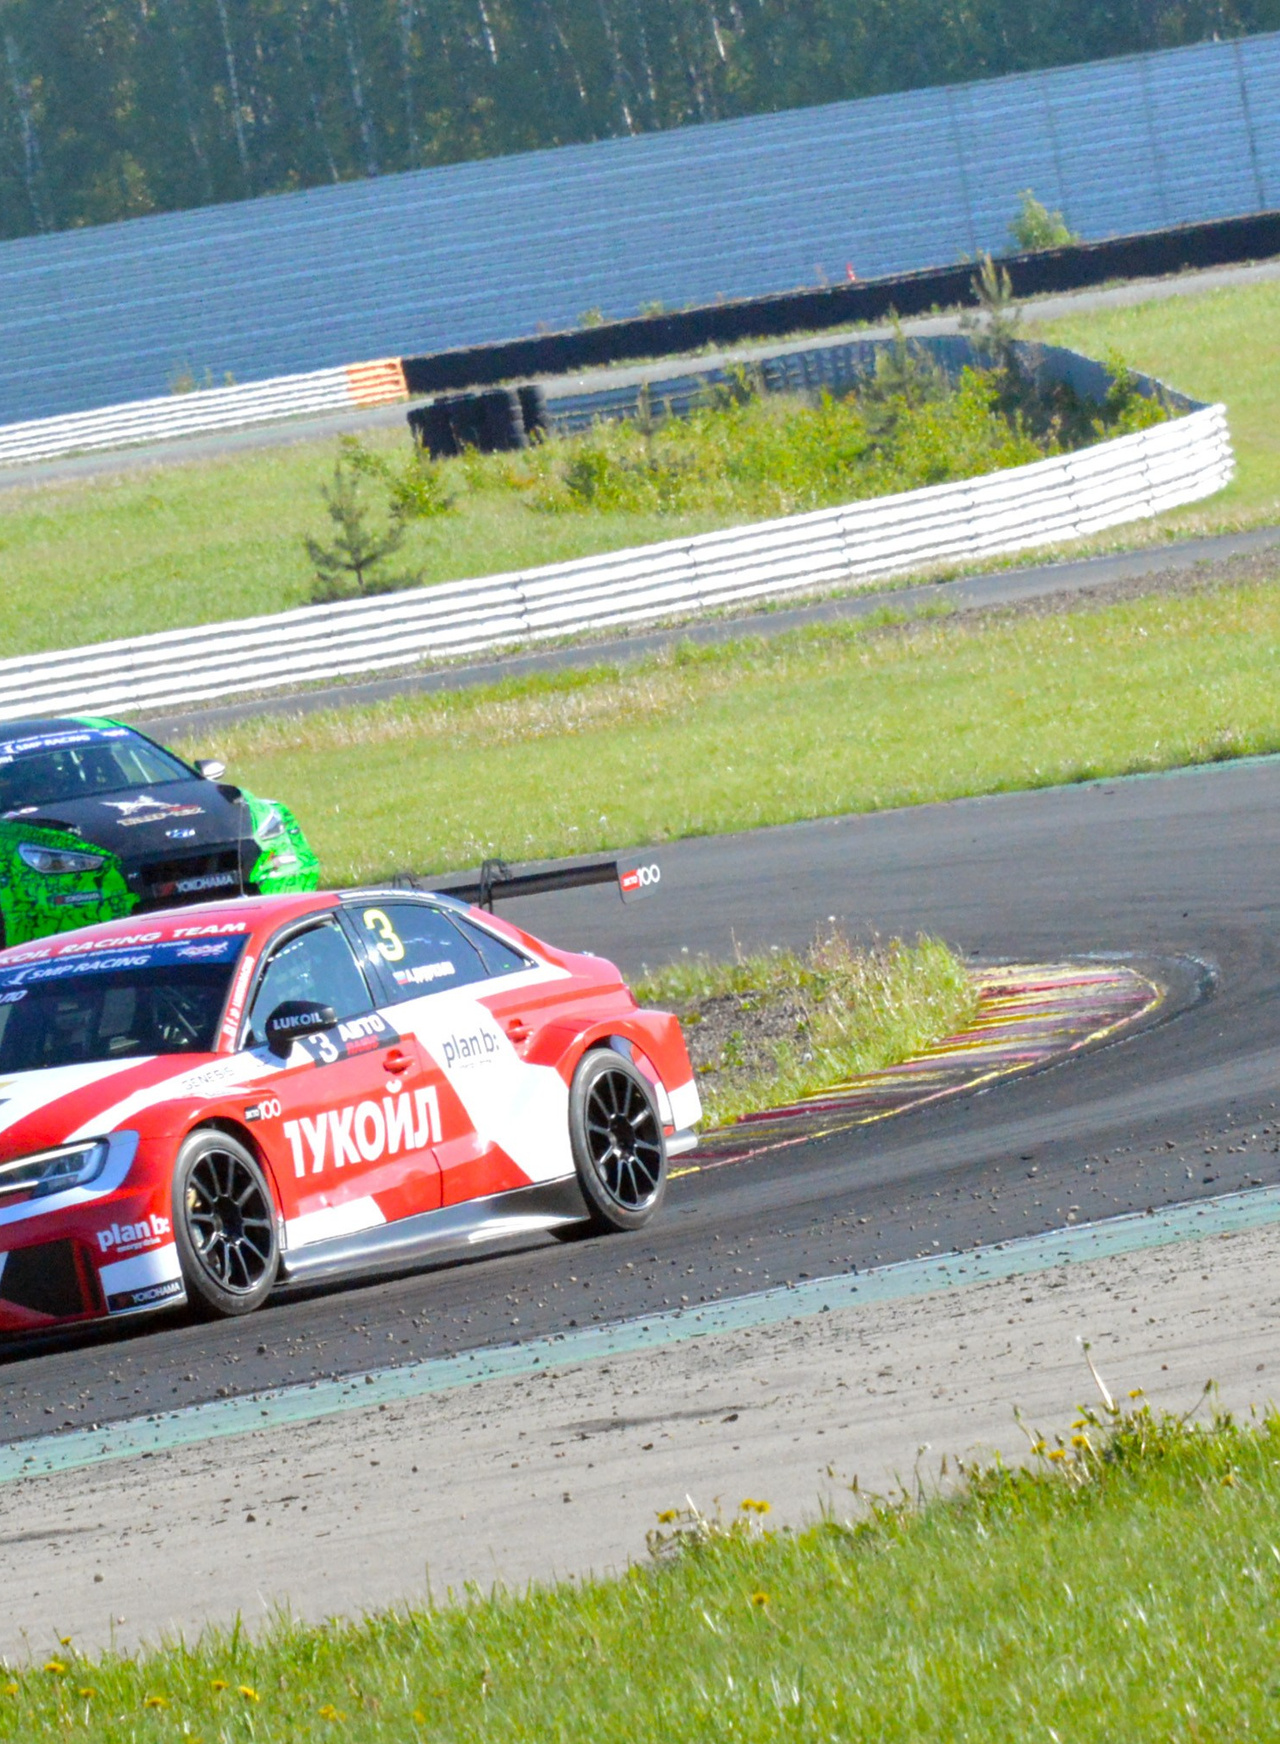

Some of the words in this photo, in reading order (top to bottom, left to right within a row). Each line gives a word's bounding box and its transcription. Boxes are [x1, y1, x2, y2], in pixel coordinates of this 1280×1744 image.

[636, 864, 661, 887] 100
[59, 931, 162, 955] RACING
[172, 922, 247, 938] TEAM
[363, 908, 406, 962] 3
[27, 965, 73, 980] SMP
[72, 954, 152, 973] RACING
[272, 1011, 323, 1031] LUKOIL
[308, 1032, 340, 1064] 3
[442, 1034, 482, 1069] plan
[97, 1221, 151, 1253] plan
[130, 1281, 182, 1303] YOKOHAMA
